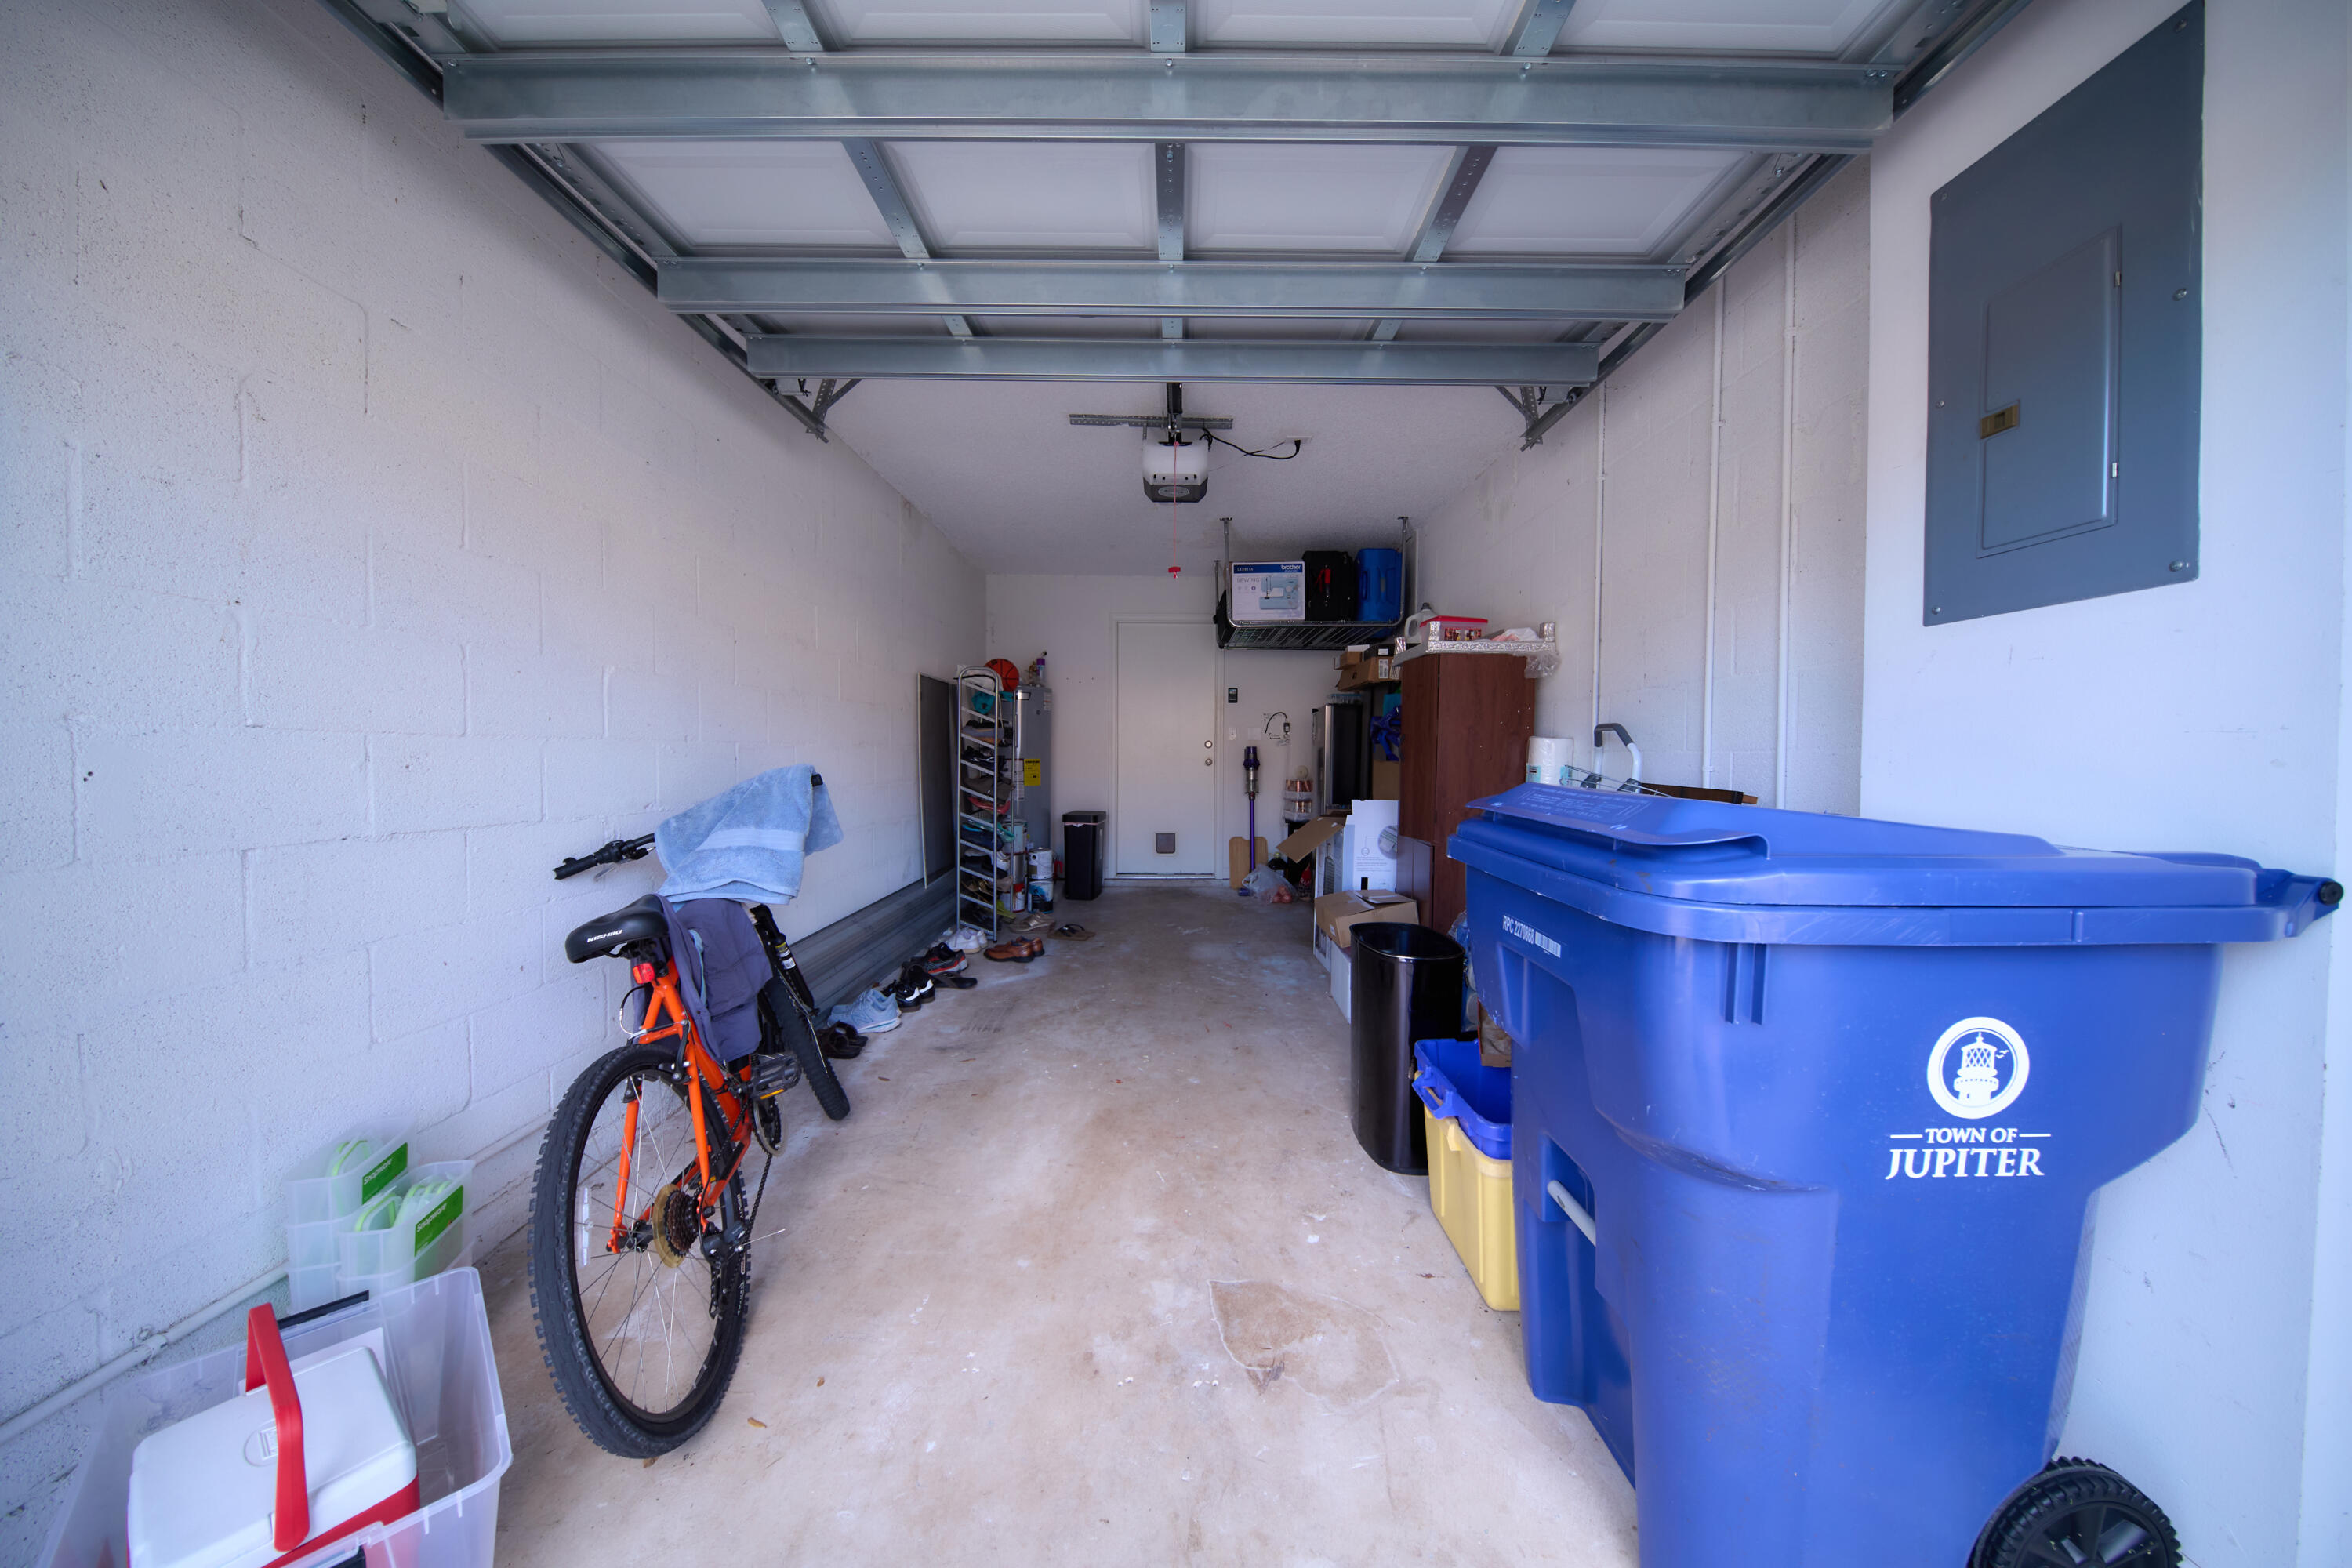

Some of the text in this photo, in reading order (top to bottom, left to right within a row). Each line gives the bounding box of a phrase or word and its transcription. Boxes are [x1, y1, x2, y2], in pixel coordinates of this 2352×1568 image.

[586, 929, 622, 942] NISHIKI
[1502, 915, 1514, 934] RPC
[1925, 1127, 2018, 1144] TOWN OF
[363, 1158, 392, 1185] Snapware
[1885, 1148, 2045, 1180] JUPITER
[416, 1203, 447, 1232] Snapware
